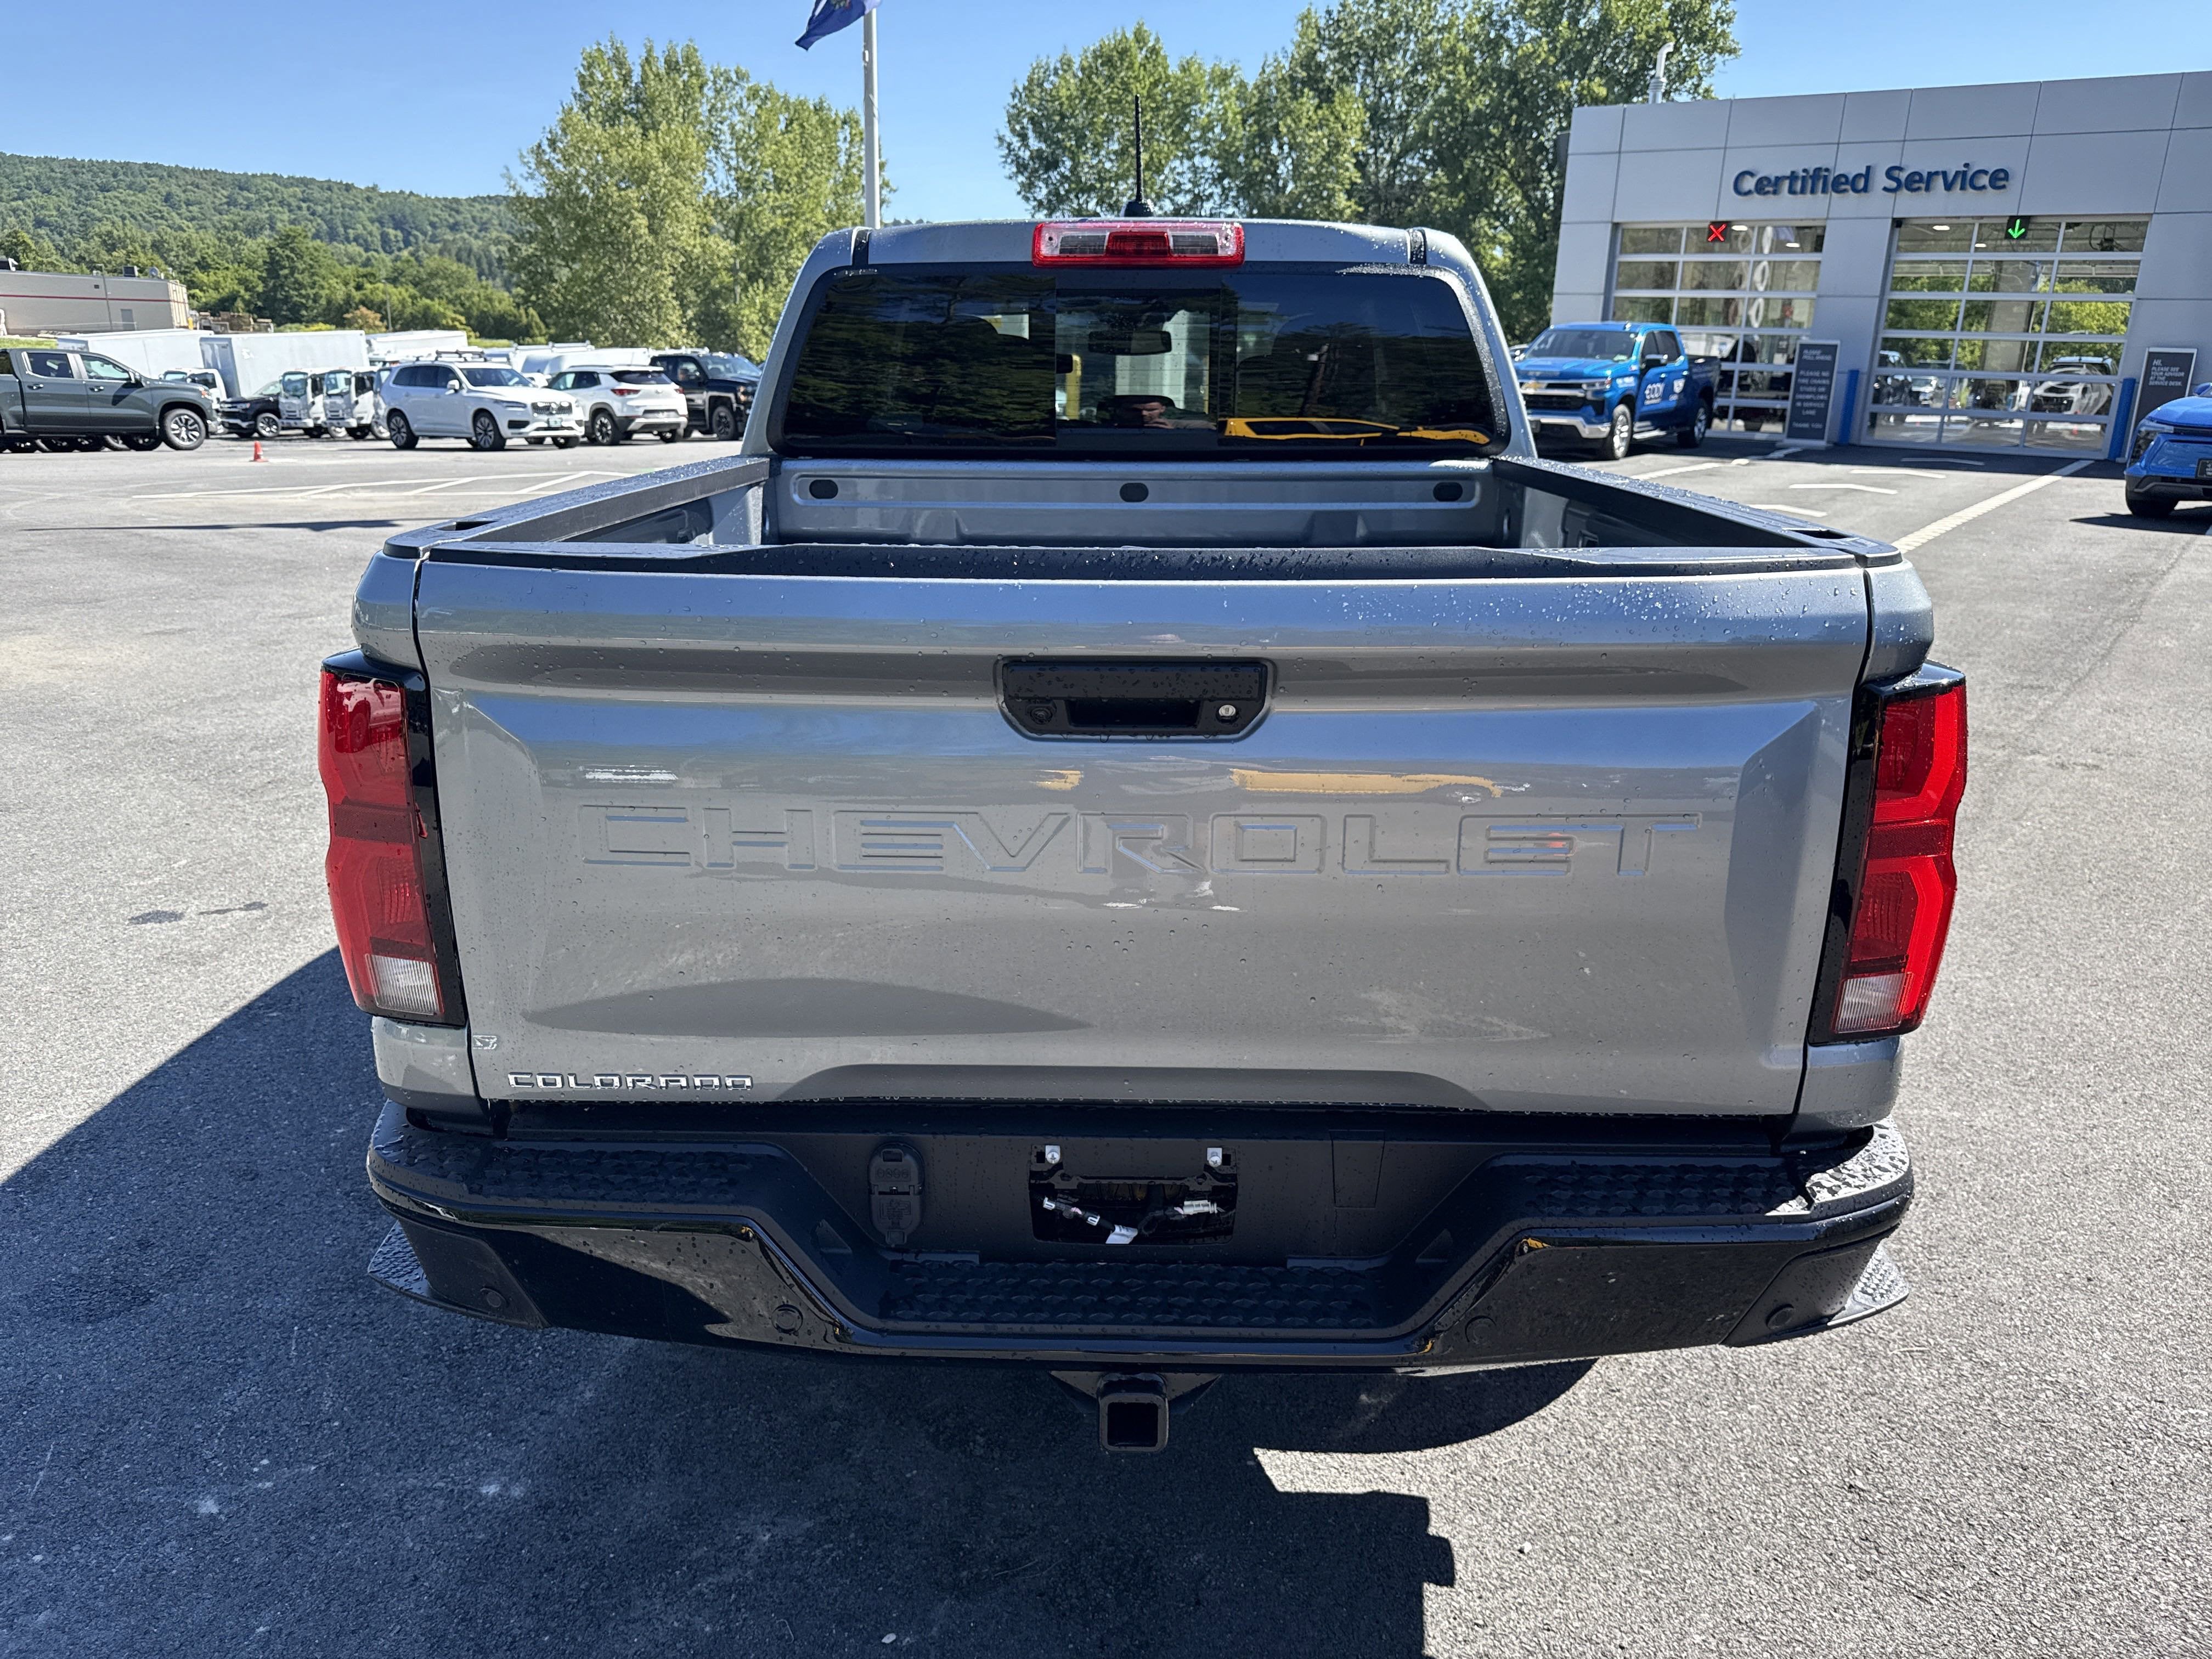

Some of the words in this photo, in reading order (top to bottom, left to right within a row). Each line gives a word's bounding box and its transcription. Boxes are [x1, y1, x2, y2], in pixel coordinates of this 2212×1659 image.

[1733, 165, 1871, 196] Certified
[1882, 163, 2010, 194] Service
[579, 804, 1702, 876] CHEVROLET
[507, 1071, 753, 1091] COLORADO
